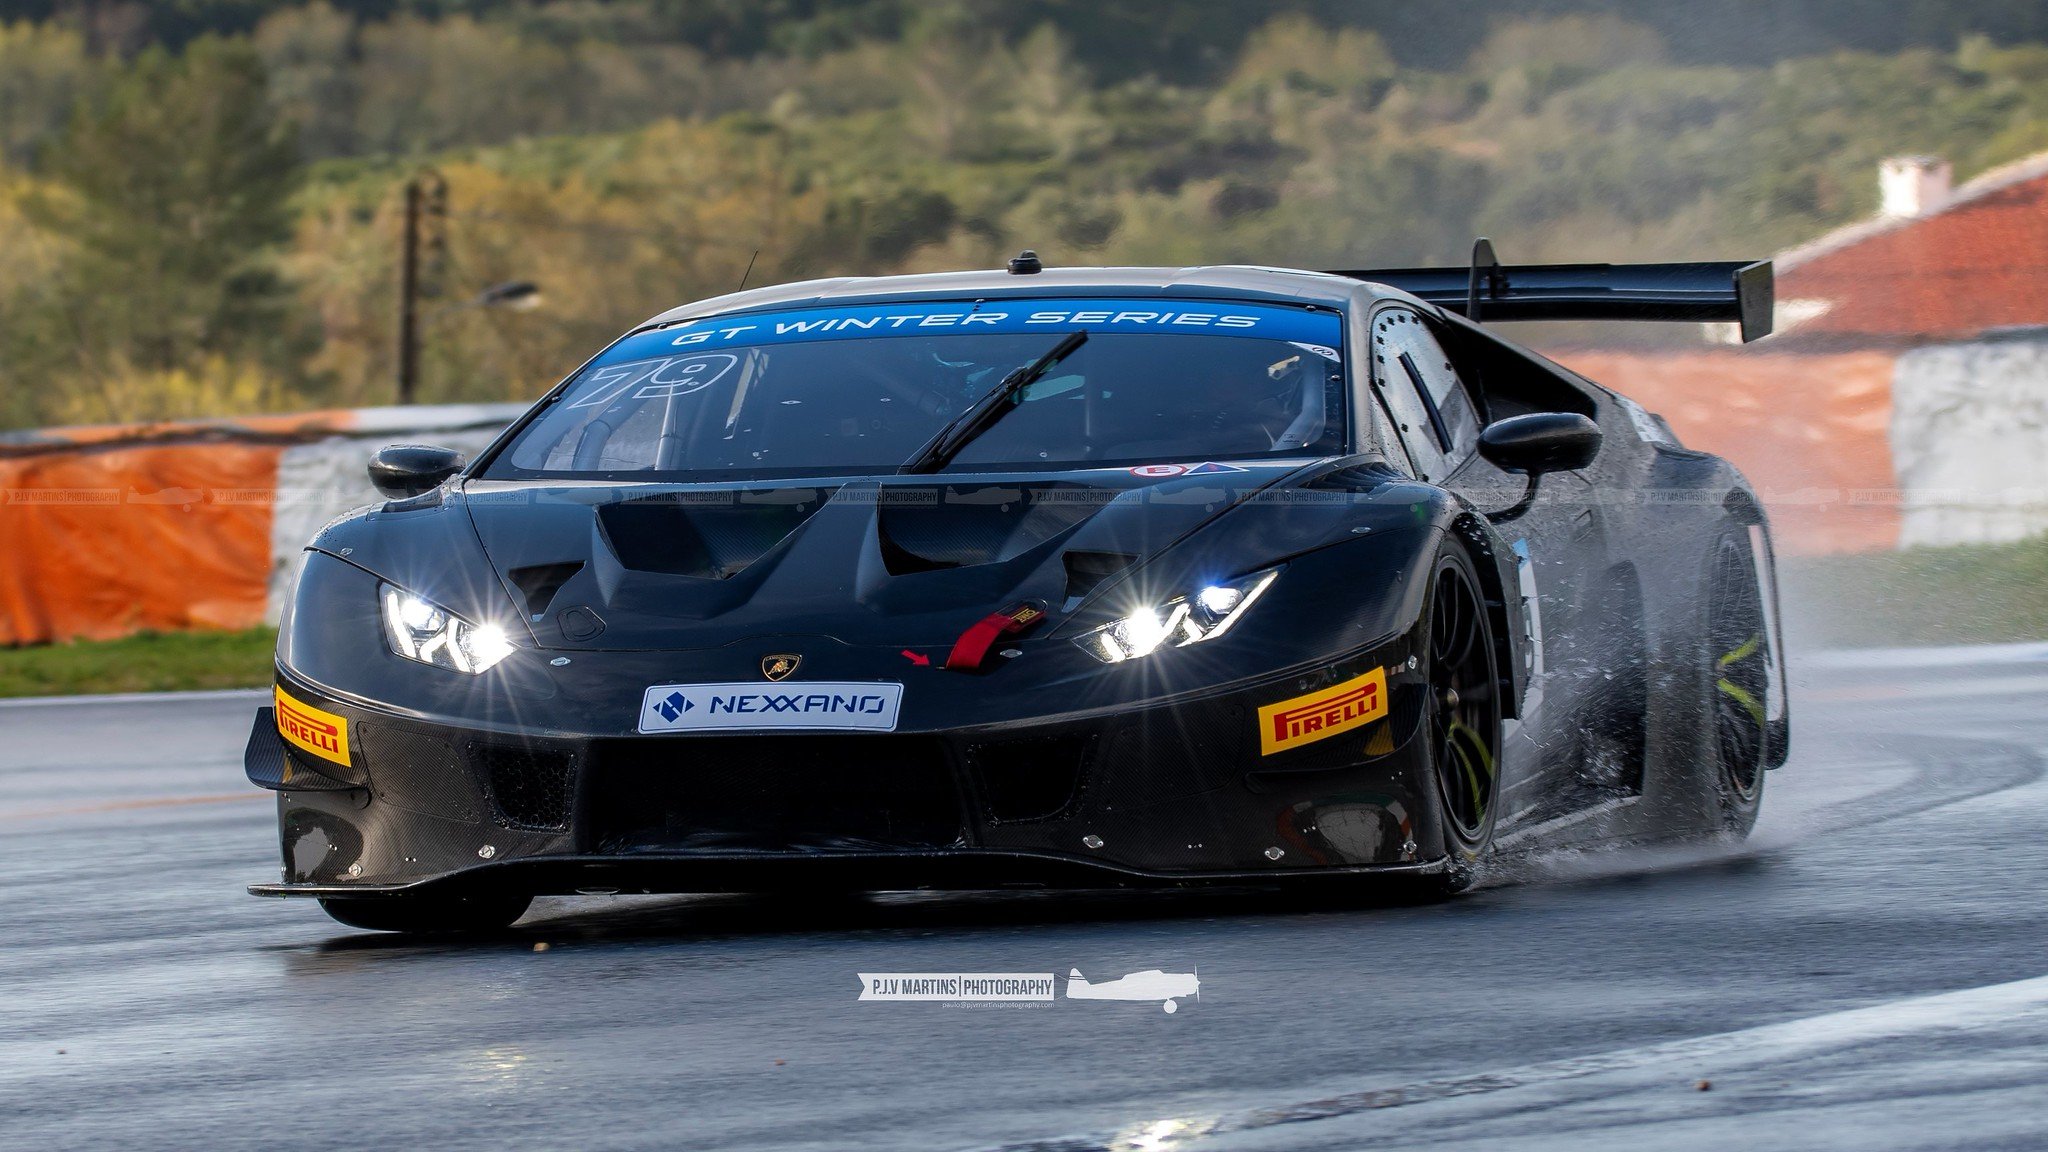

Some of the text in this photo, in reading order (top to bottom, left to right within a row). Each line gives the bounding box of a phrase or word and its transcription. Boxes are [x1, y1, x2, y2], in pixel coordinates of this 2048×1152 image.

[672, 311, 1261, 346] GT WINTER SERIES
[567, 354, 738, 410] 79
[278, 699, 339, 754] PIRELLI
[709, 694, 885, 714] NEXXANO
[1273, 682, 1378, 742] PIRELLI
